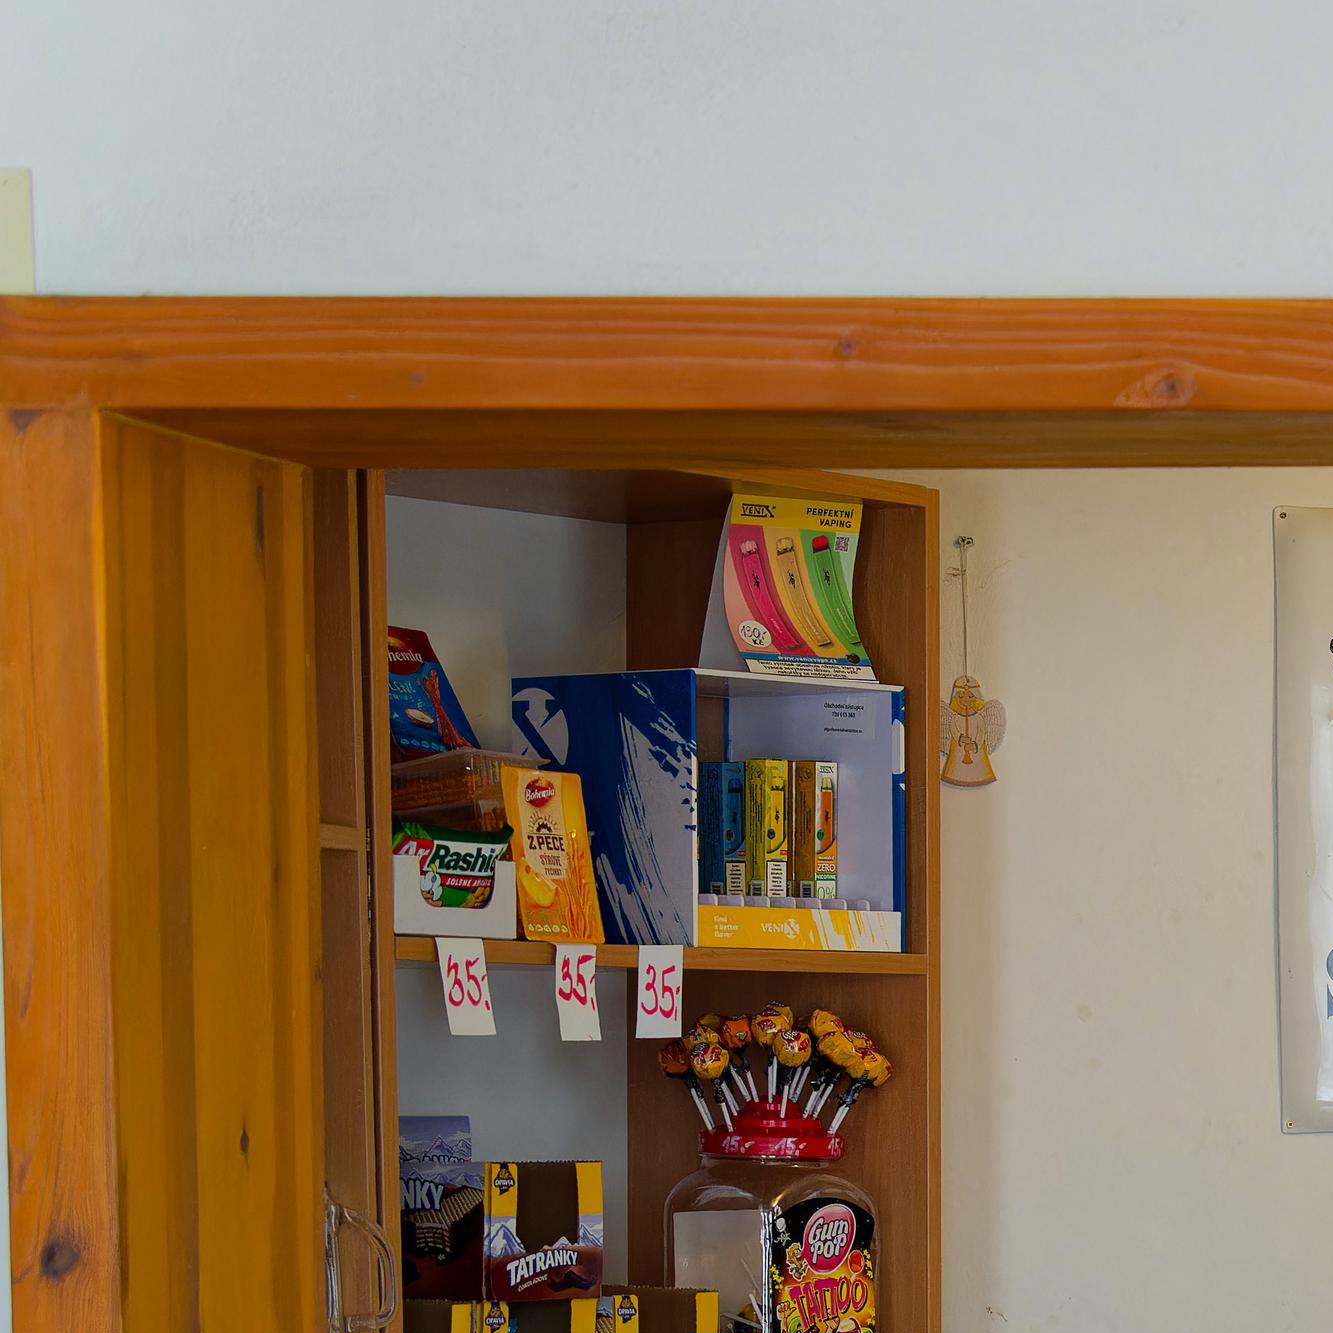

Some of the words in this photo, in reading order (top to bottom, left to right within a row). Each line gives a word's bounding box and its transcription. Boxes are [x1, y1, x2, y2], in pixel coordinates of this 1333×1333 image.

[741, 504, 776, 519] VENIX
[806, 507, 854, 519] PERFEKTNÍ
[819, 518, 853, 529] VAPING
[525, 787, 556, 802] Bohemia
[527, 835, 537, 850] Z
[538, 835, 566, 852] PECE
[817, 863, 835, 873] ZERO
[506, 1248, 580, 1288] TATRANKY
[789, 1276, 869, 1333] TATTOO
